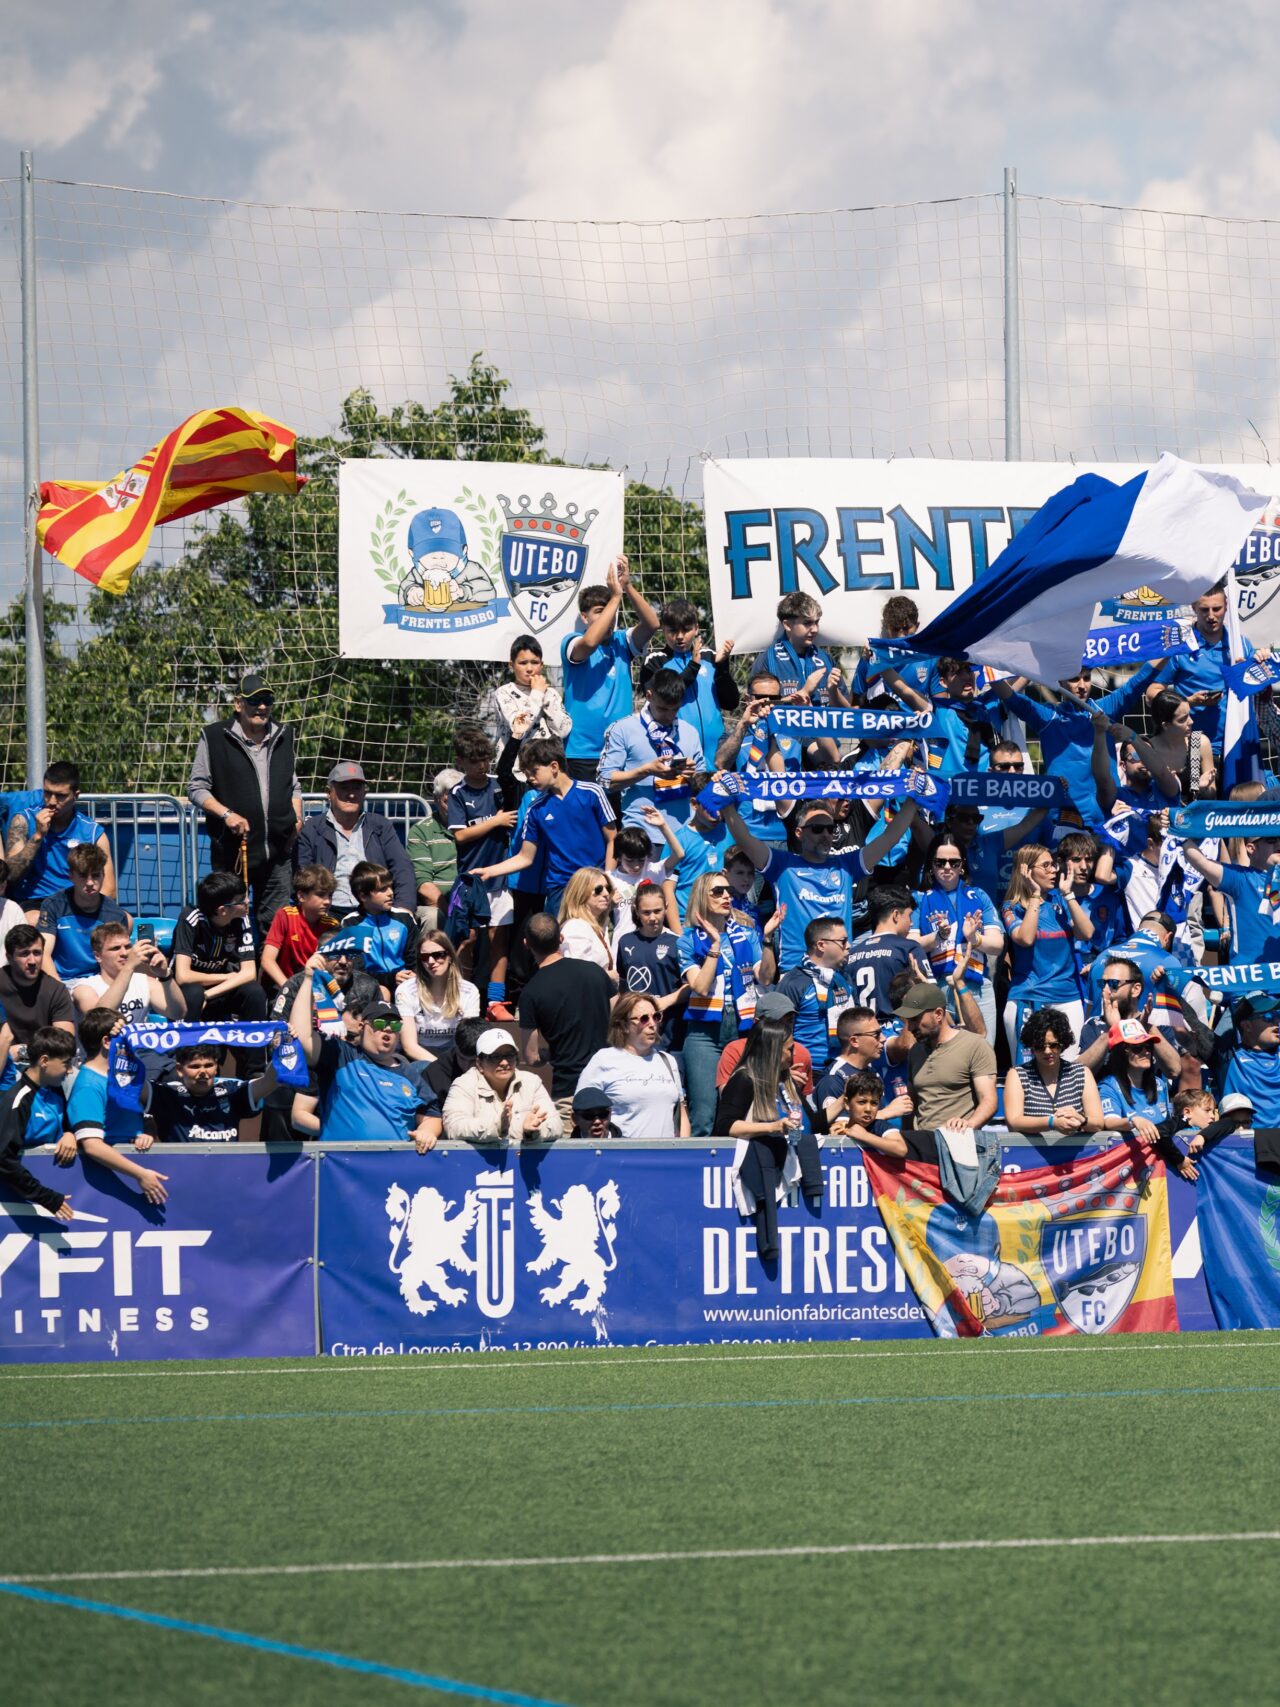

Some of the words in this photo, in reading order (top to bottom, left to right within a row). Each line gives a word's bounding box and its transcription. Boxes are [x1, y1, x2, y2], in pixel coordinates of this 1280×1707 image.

[509, 541, 578, 577] UTEBO
[1238, 590, 1256, 609] FC
[400, 614, 451, 629] FRENTE
[454, 609, 495, 628] BARBO
[529, 600, 549, 622] FC
[1115, 607, 1163, 621] FRENTE
[1117, 633, 1141, 654] FC
[773, 708, 855, 729] FRENTE
[862, 711, 933, 730] BARBO
[757, 780, 806, 797] 100
[986, 779, 1055, 798] BARBO
[128, 1030, 181, 1049] 100
[703, 1227, 758, 1294] DE
[778, 1226, 906, 1294] TRES
[1052, 1225, 1136, 1275] UTEBO
[1081, 1300, 1107, 1326] FC
[331, 1342, 367, 1357] Ctra
[372, 1342, 394, 1356] de
